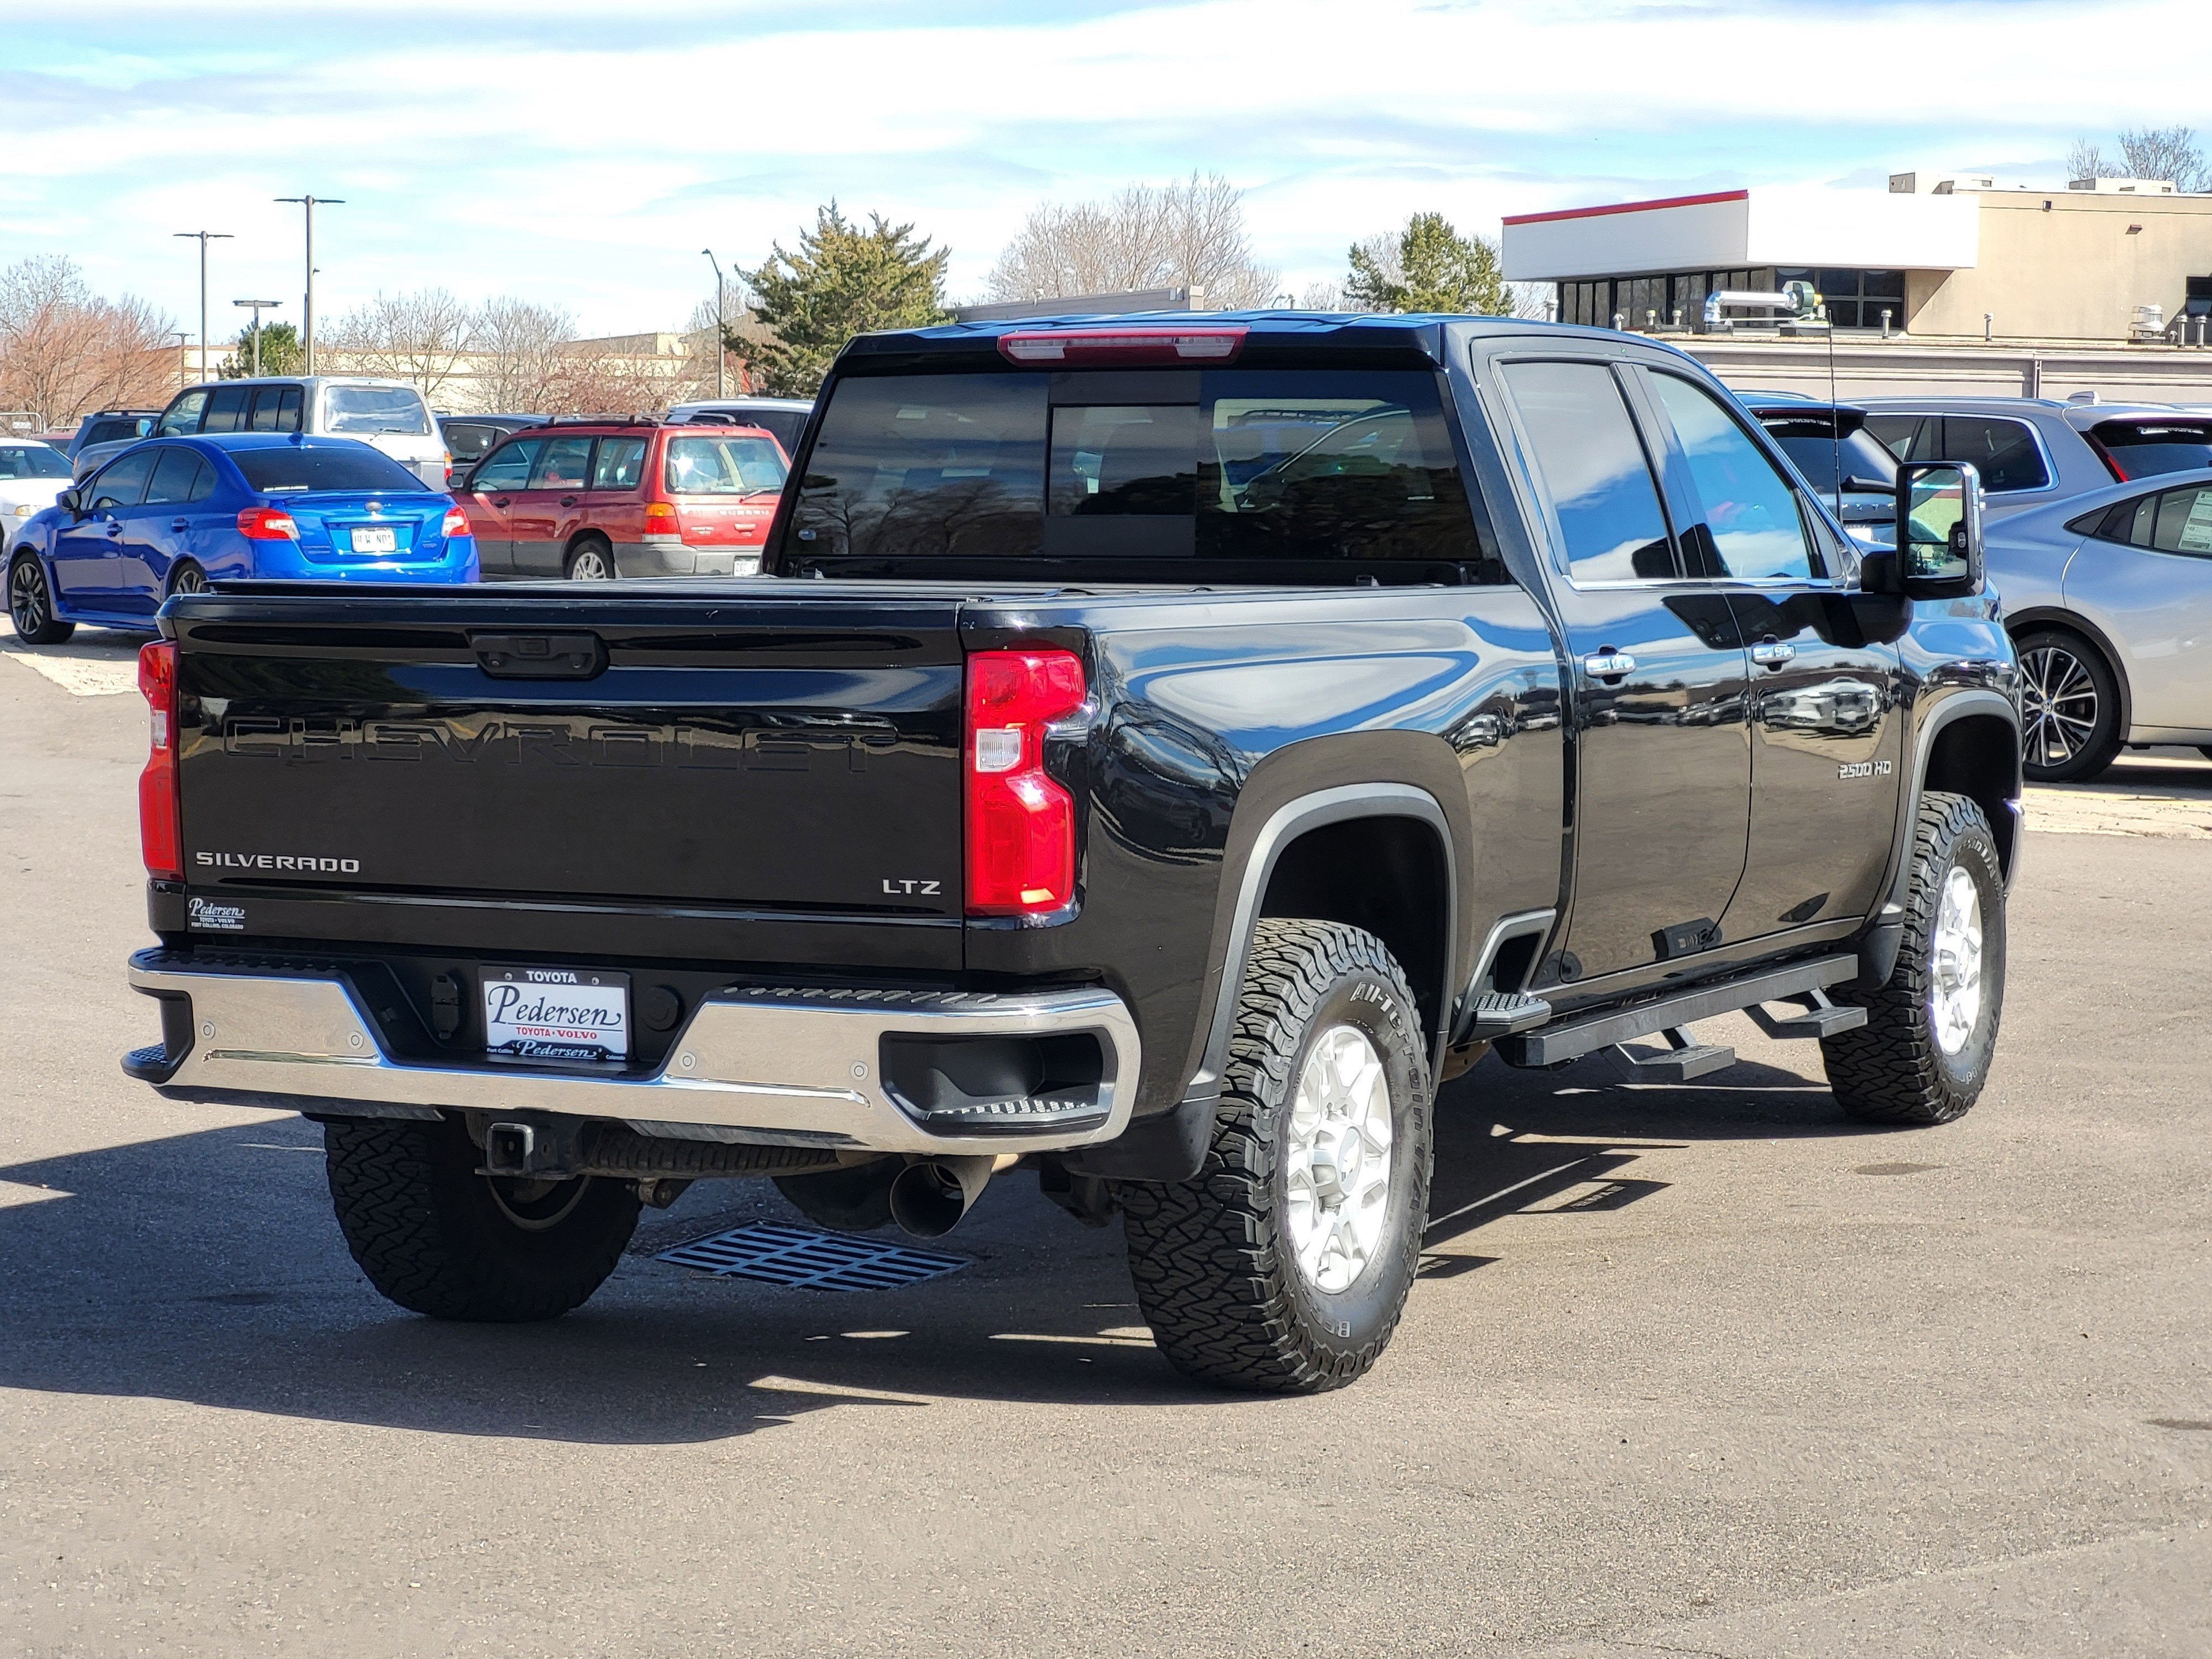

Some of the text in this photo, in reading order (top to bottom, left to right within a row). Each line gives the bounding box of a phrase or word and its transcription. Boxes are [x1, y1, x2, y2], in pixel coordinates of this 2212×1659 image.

[223, 717, 897, 773] CHEVROLET
[1838, 760, 1892, 780] 2500 HD
[196, 852, 359, 873] SILVERADO
[883, 879, 941, 895] LTZ
[189, 897, 244, 917] Pedersen
[526, 971, 577, 984] TOYOTA
[488, 985, 622, 1025] Pedersen
[515, 1027, 598, 1040] TOYOTA VOLVO
[517, 1039, 597, 1057] Pedersen
